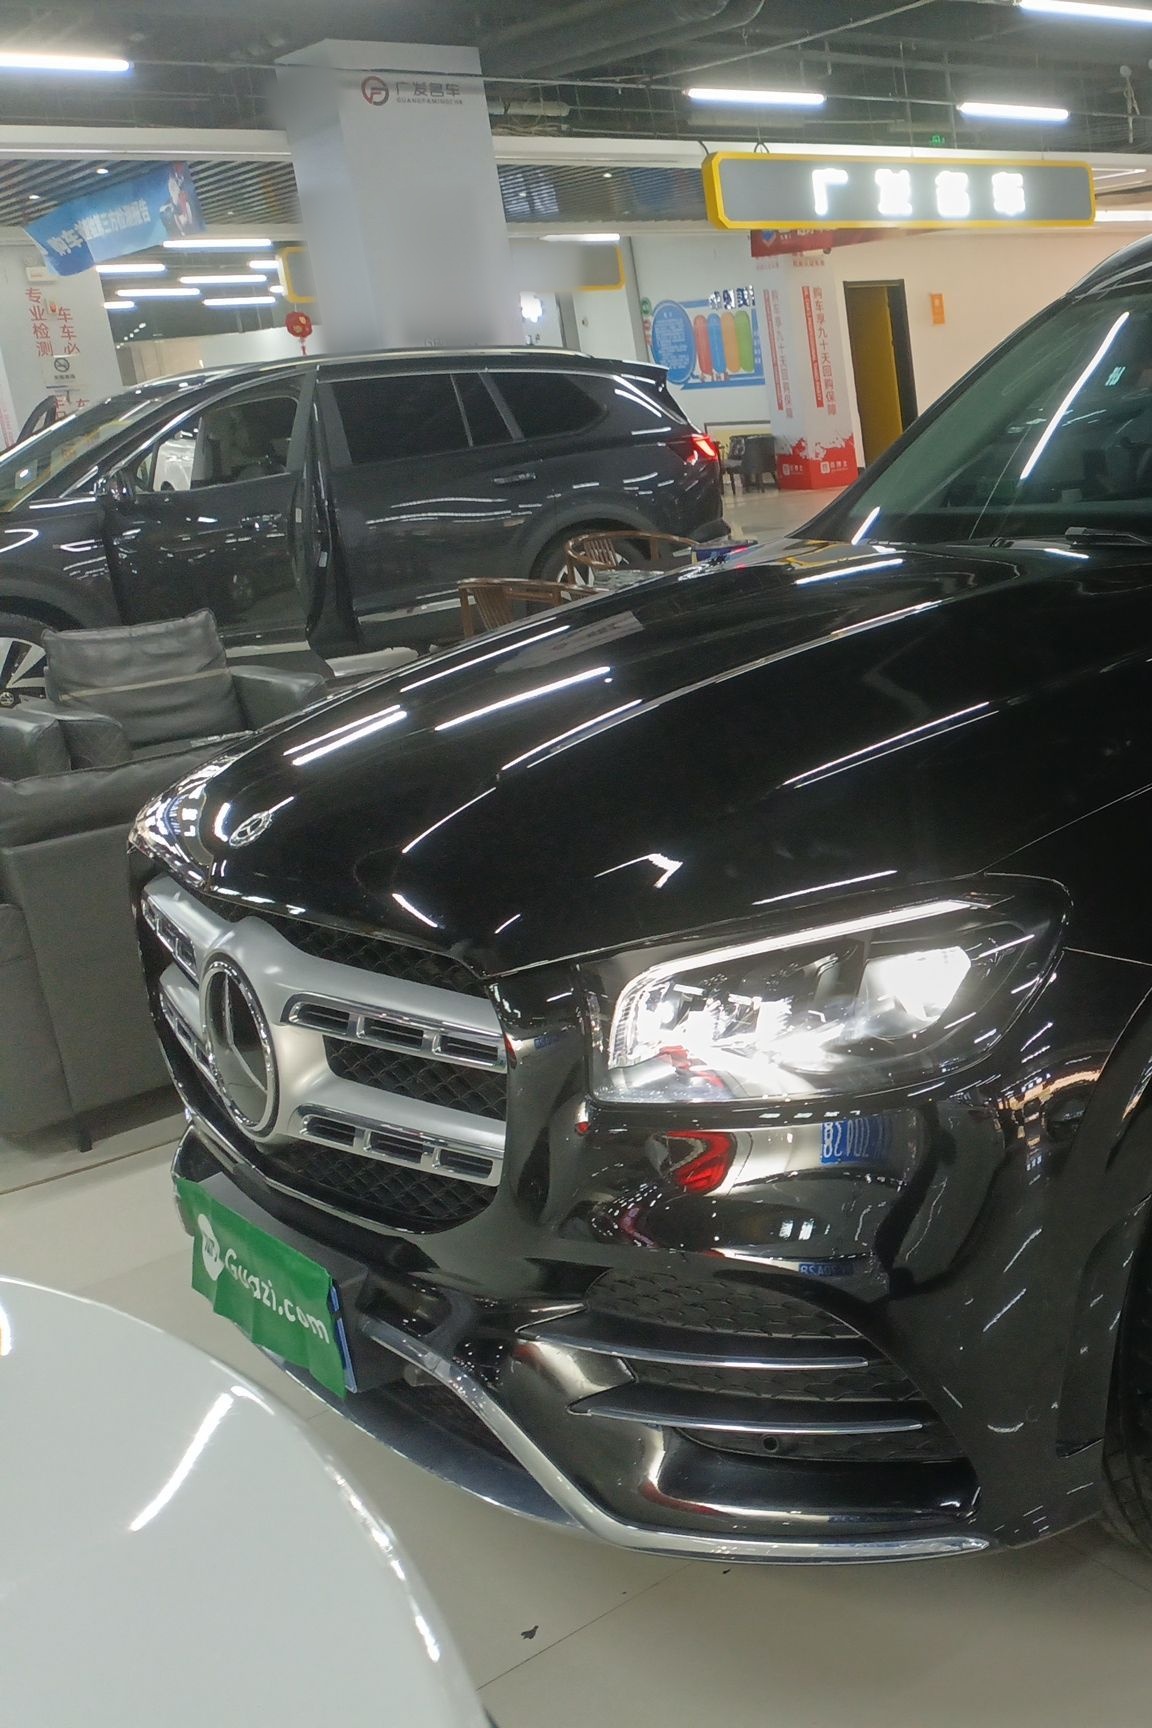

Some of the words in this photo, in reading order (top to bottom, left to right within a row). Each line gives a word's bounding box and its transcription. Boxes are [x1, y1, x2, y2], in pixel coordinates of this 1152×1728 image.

[25, 287, 54, 357] 专业检测
[224, 1248, 330, 1344] Guazi.com
